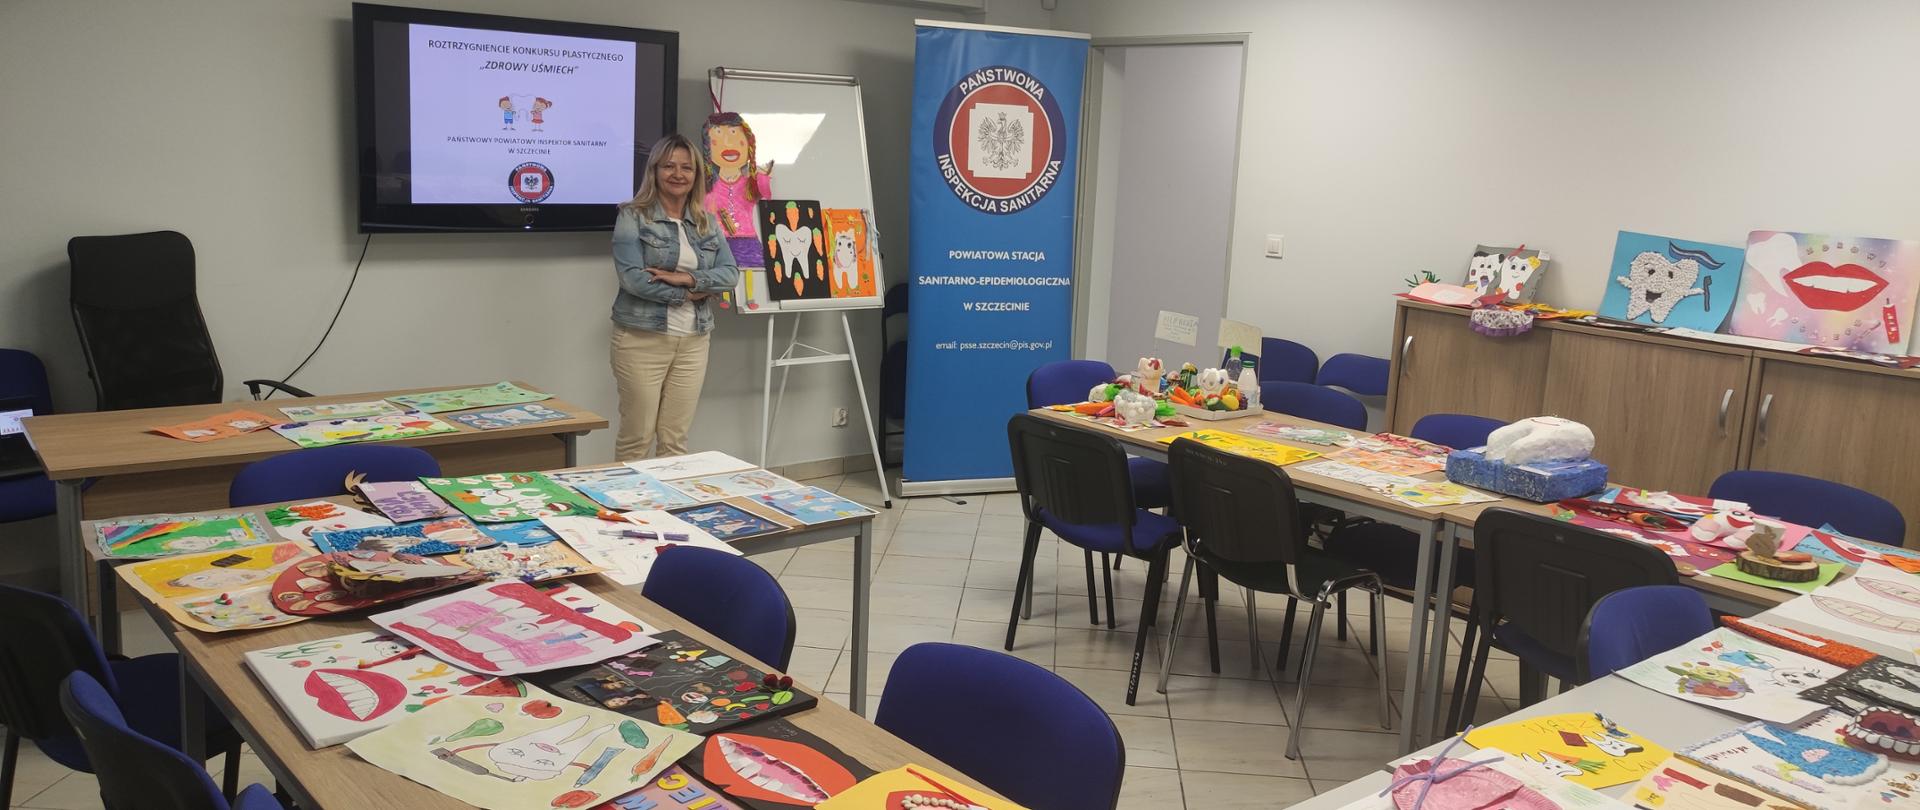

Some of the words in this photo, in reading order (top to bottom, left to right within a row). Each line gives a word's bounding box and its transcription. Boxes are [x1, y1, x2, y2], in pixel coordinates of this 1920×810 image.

[428, 39, 510, 54] ROZTRZYGNIENCIE
[512, 47, 560, 58] KONKURSU
[562, 50, 624, 62] PLASTYCZNEGO
[959, 68, 1045, 101] PAŃSTWOWA
[494, 137, 537, 145] POWIATOWY
[938, 153, 997, 213] INSPEKCJA
[1000, 159, 1062, 213] SANITARNA
[949, 250, 1010, 260] POWIATOWA
[1011, 251, 1046, 262] STACJA
[918, 275, 1071, 287] SANITARNO-EPIDEMIOLOGICZNA
[963, 302, 975, 311] W
[975, 302, 1030, 312] SZCZECINIE
[959, 340, 1053, 352] psse.szczecin@pis.gov.pl
